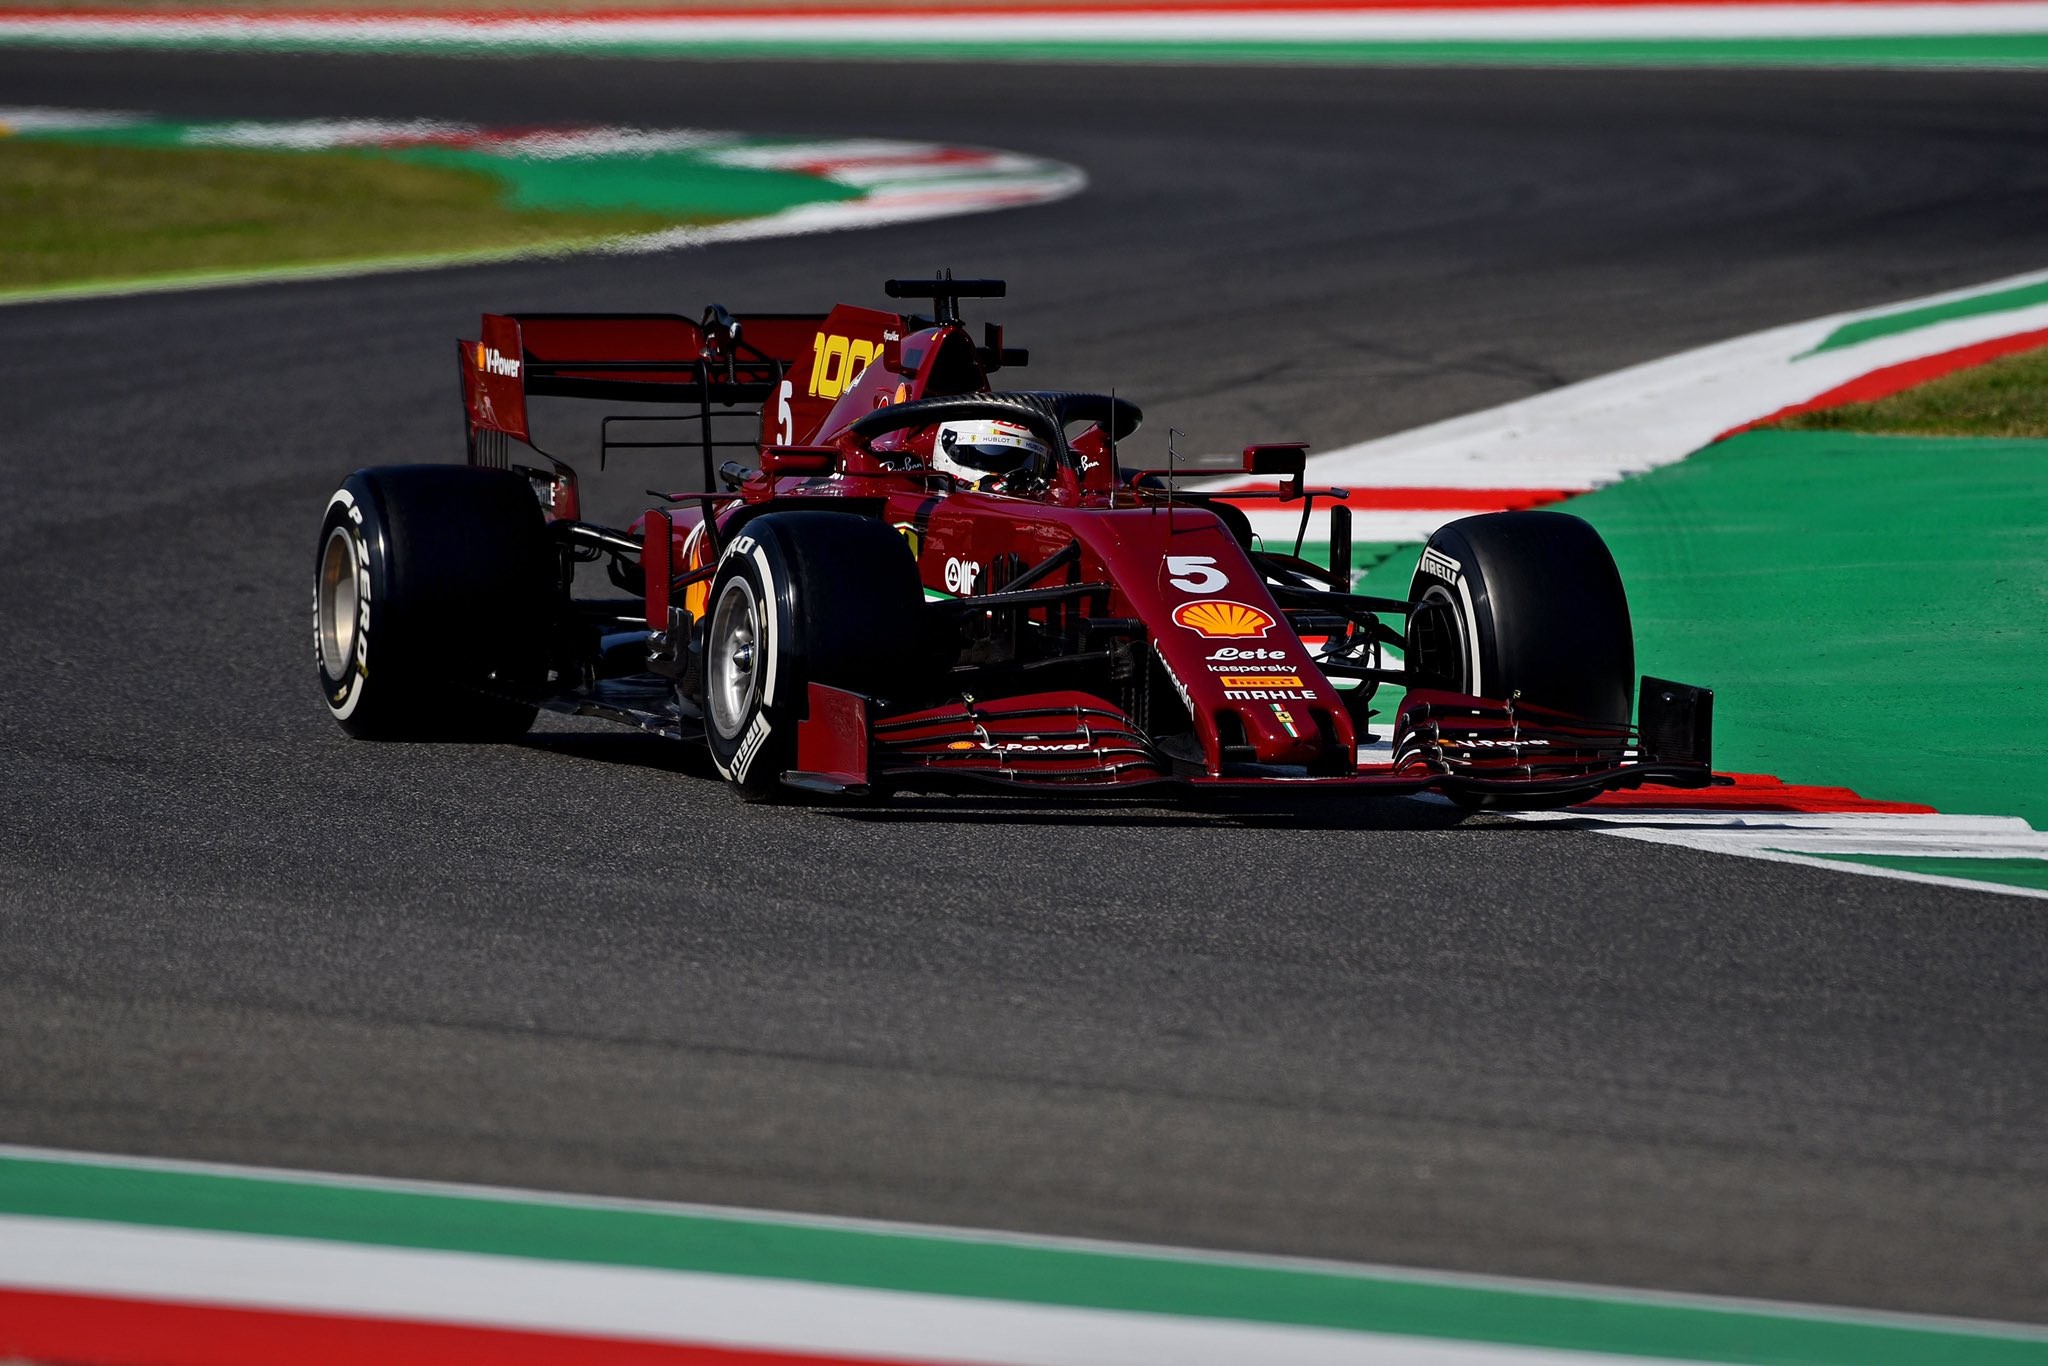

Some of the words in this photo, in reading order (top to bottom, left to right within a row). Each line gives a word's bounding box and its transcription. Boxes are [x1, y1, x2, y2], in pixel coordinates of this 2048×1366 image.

[485, 347, 520, 378] V-Power
[776, 380, 793, 446] 5
[983, 436, 1010, 444] HUBLOT
[1166, 556, 1230, 594] 5
[1420, 546, 1461, 586] PIRELLI
[356, 538, 372, 668] ZERO
[1206, 664, 1298, 673] kaspersky
[1223, 690, 1318, 700] MAHLE
[730, 710, 772, 784] PIRELLI
[979, 742, 1090, 751] V-Power
